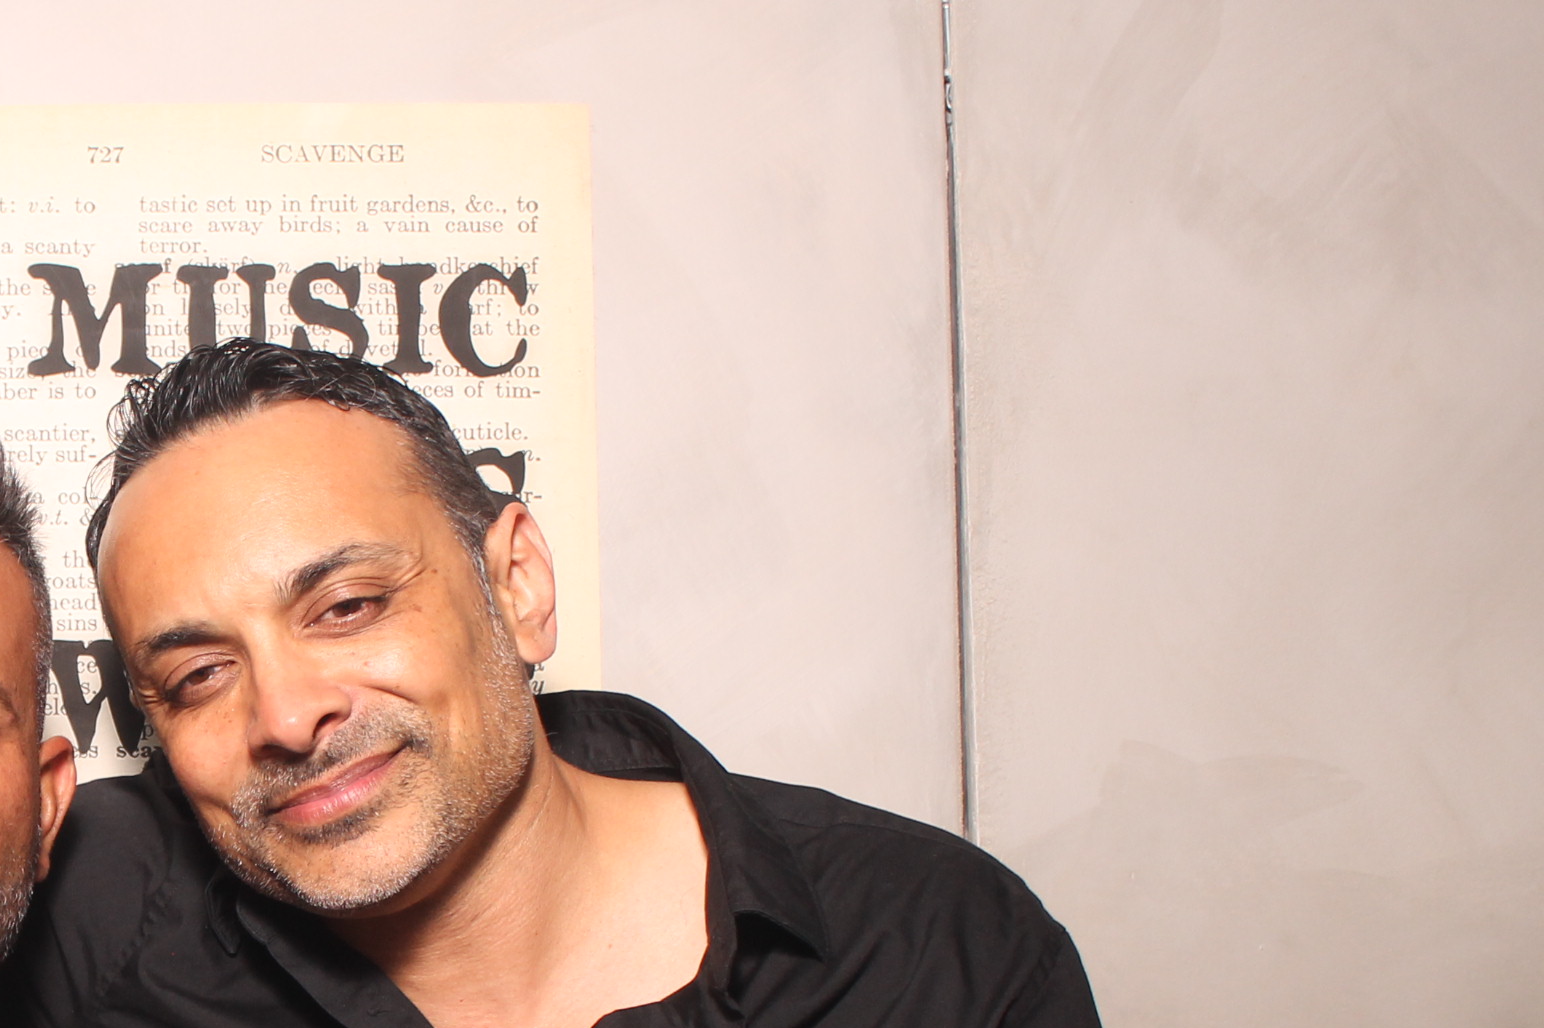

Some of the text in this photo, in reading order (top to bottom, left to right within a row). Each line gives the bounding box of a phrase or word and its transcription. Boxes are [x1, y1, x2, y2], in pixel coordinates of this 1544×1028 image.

[87, 146, 124, 164] 727
[260, 144, 405, 163] SCAVENGE
[75, 198, 96, 214] to
[139, 194, 198, 213] tastic
[206, 196, 237, 213] set
[246, 199, 272, 215] up
[282, 194, 302, 213] in
[311, 194, 358, 213] fruit
[367, 194, 456, 215] gardens,
[517, 196, 538, 213] to
[138, 215, 538, 236] scare away birds; a vain cause of
[1, 241, 14, 254] a
[24, 240, 96, 258] scanty
[139, 239, 208, 254] terror.
[27, 262, 527, 377] MUSIC
[472, 320, 494, 336] at
[507, 319, 540, 336] the
[48, 382, 64, 400] is
[75, 383, 97, 400] to
[464, 380, 485, 398] of
[496, 380, 541, 398] tim-
[3, 422, 96, 443] scantier,
[56, 445, 97, 462] suf-
[55, 612, 98, 631] sins
